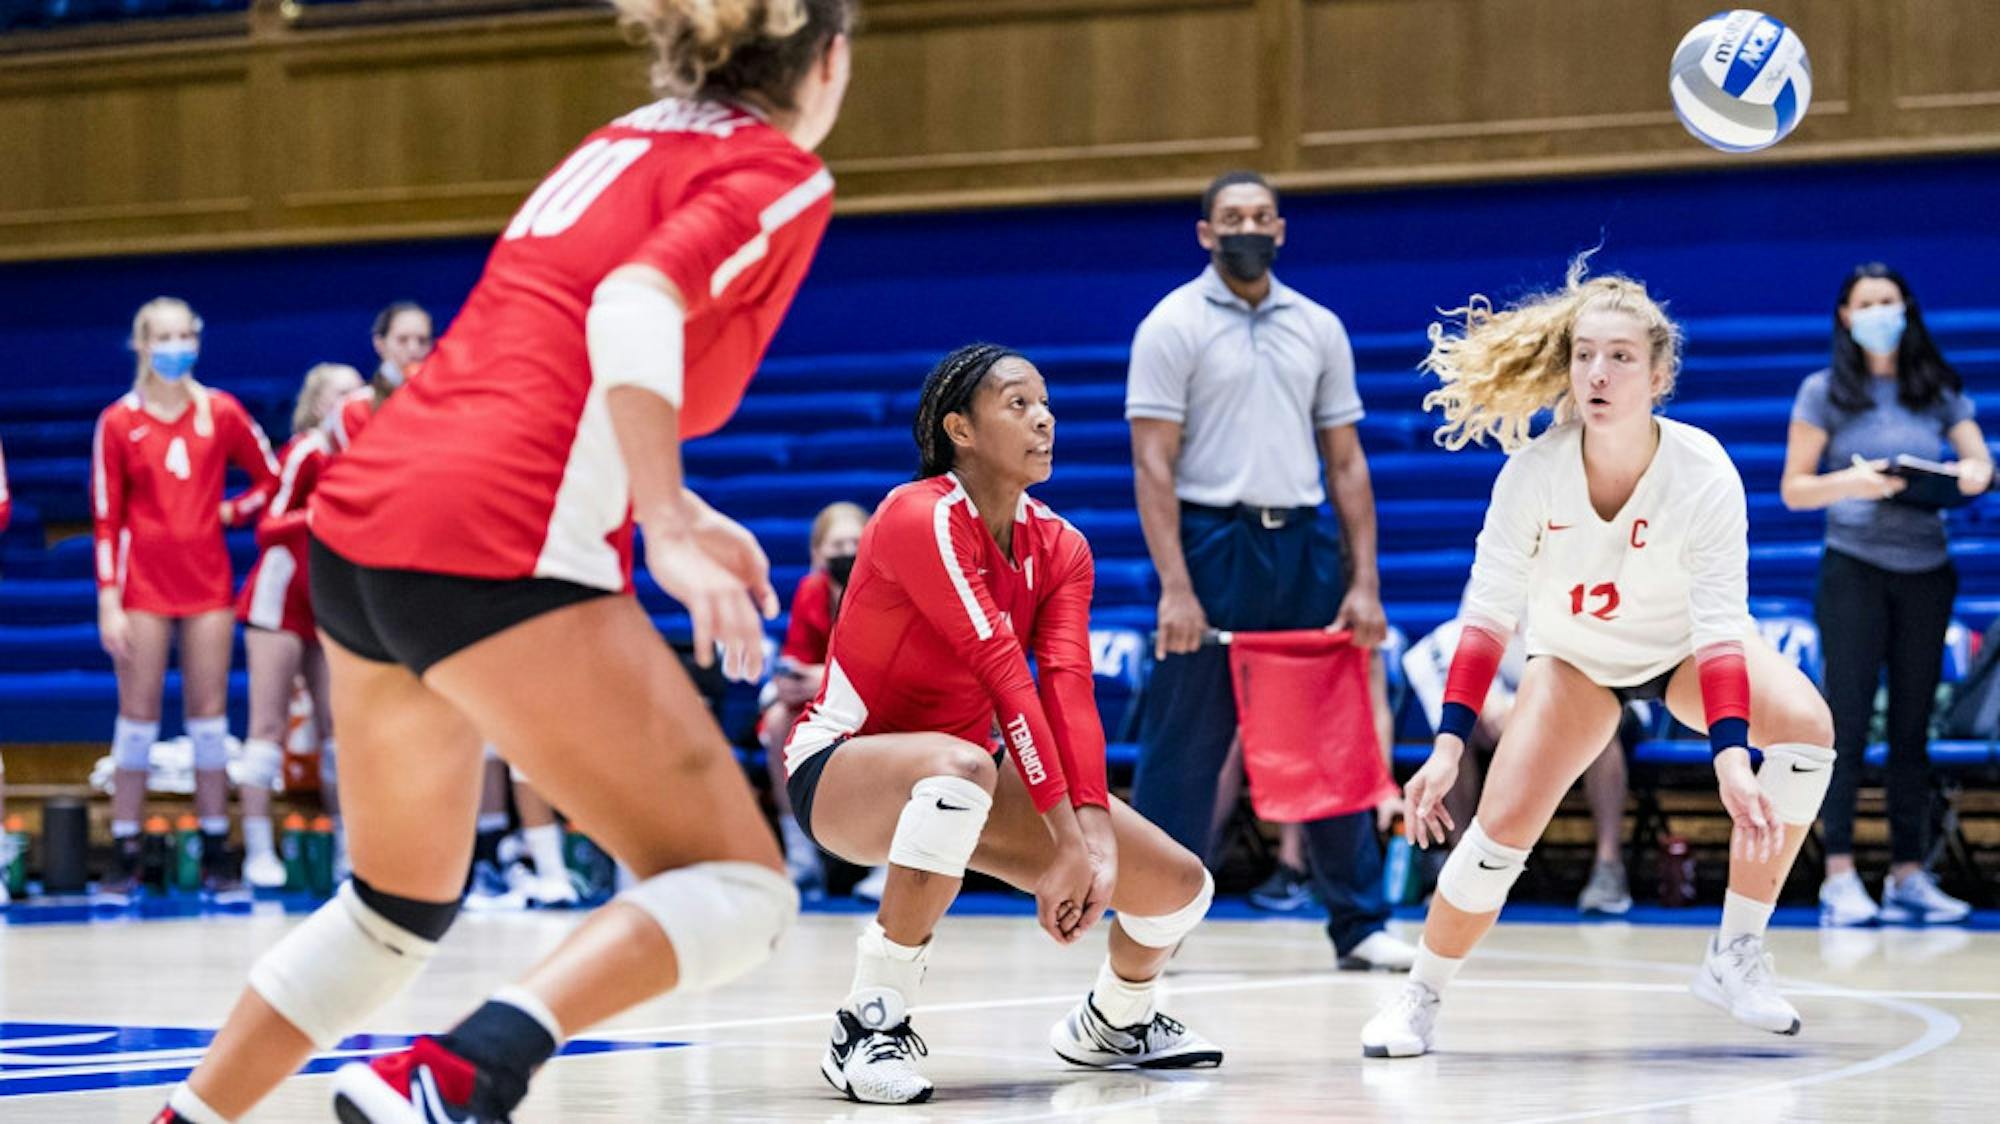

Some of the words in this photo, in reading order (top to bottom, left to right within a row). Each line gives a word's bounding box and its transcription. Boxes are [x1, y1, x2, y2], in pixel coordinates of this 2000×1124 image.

[504, 138, 652, 240] 10
[165, 436, 191, 480] 4
[1630, 518, 1649, 549] C
[1568, 581, 1621, 621] 12
[1007, 712, 1047, 785] CORNELL
